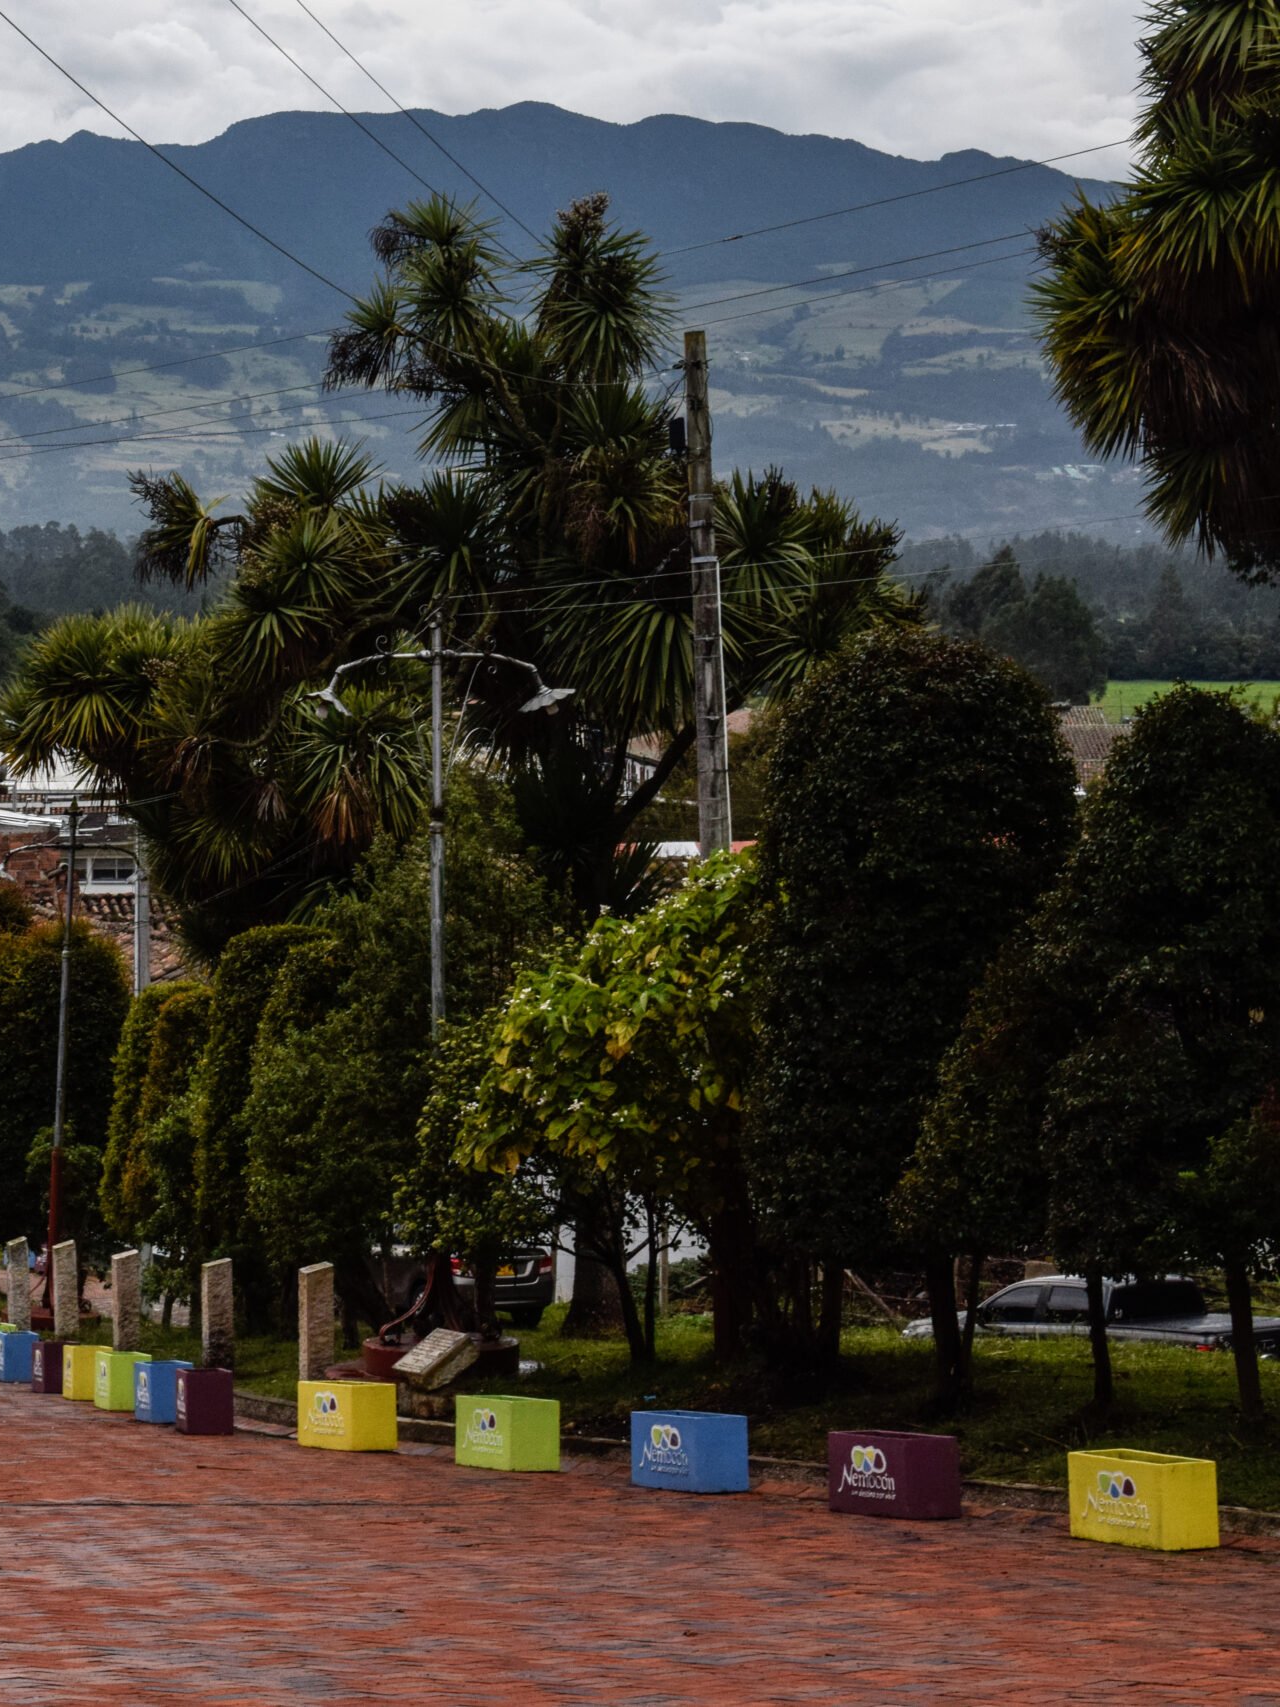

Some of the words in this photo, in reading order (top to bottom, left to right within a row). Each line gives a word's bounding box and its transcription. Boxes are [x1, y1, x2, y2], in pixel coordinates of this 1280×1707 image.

[639, 1440, 688, 1468] Nemocón
[837, 1464, 896, 1492] Nemocón
[1081, 1487, 1150, 1520] Nemocón
